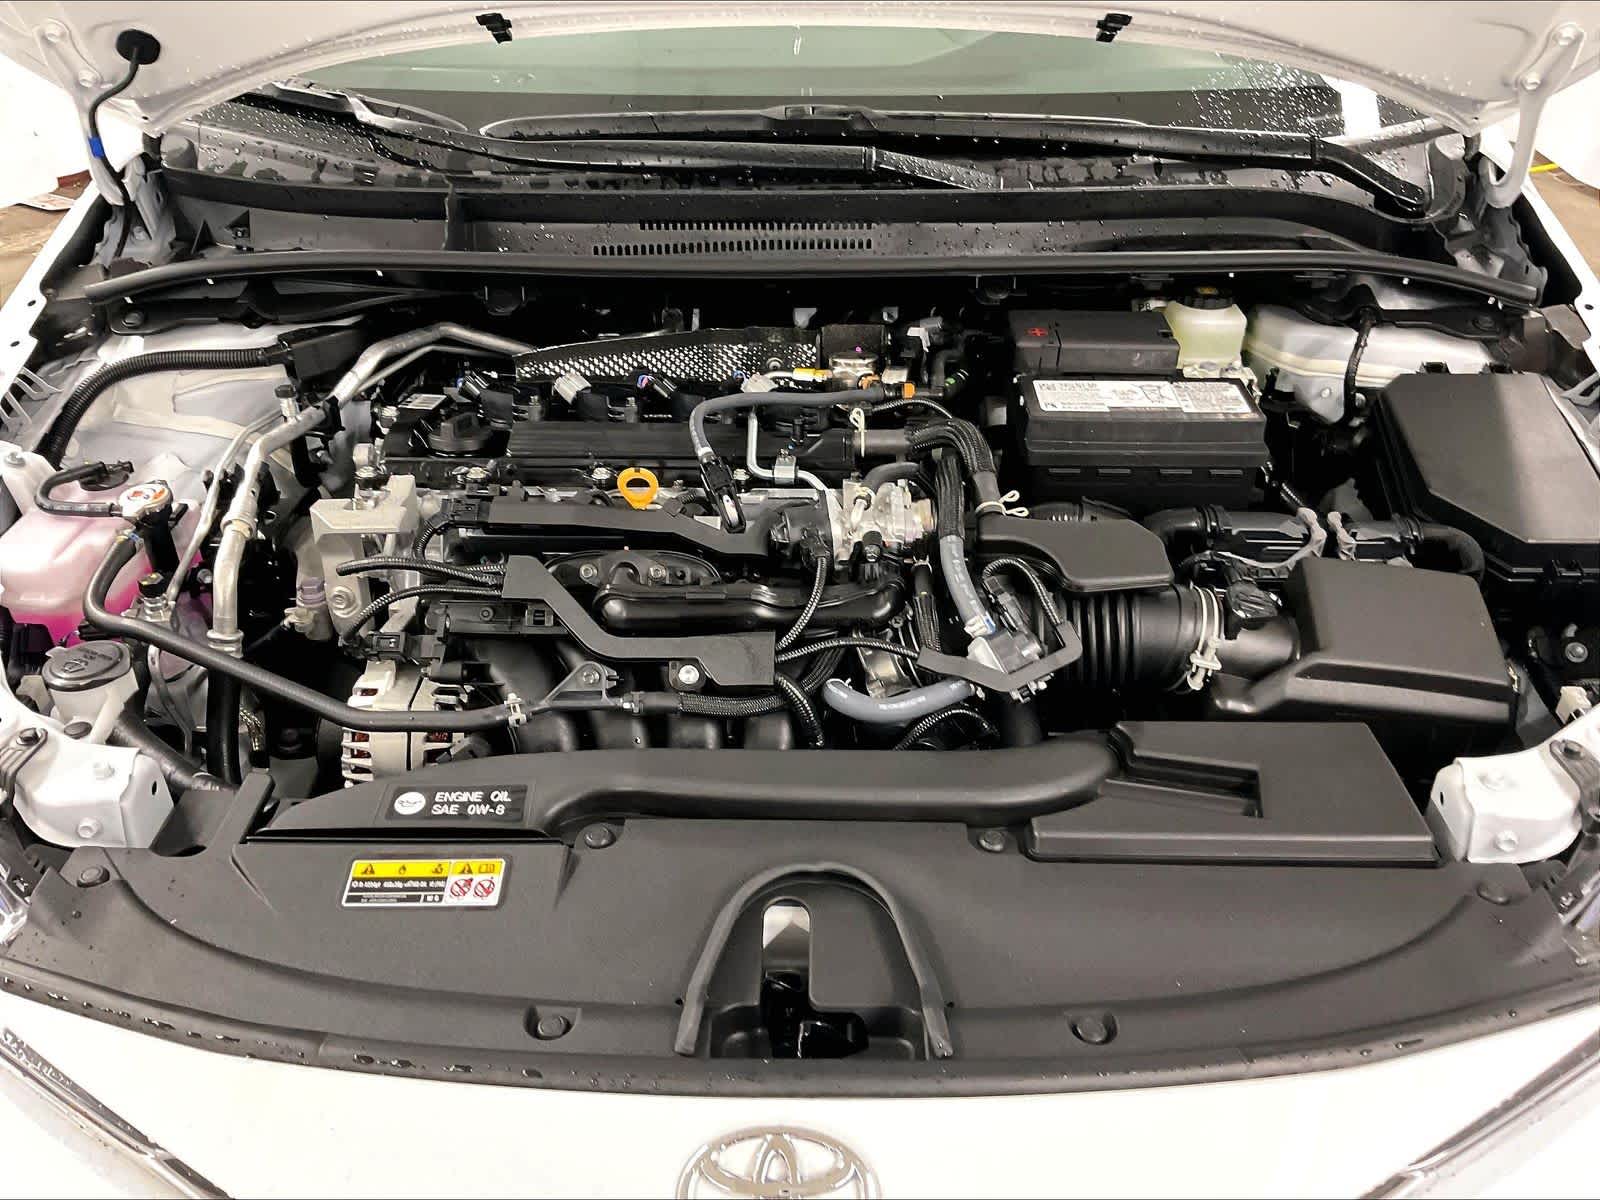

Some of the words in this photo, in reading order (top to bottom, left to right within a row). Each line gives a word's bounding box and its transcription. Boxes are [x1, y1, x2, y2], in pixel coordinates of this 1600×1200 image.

[434, 791, 484, 802] ENGINE
[490, 790, 512, 802] OIL
[431, 803, 460, 815] SAE
[467, 803, 506, 815] 0W-8
